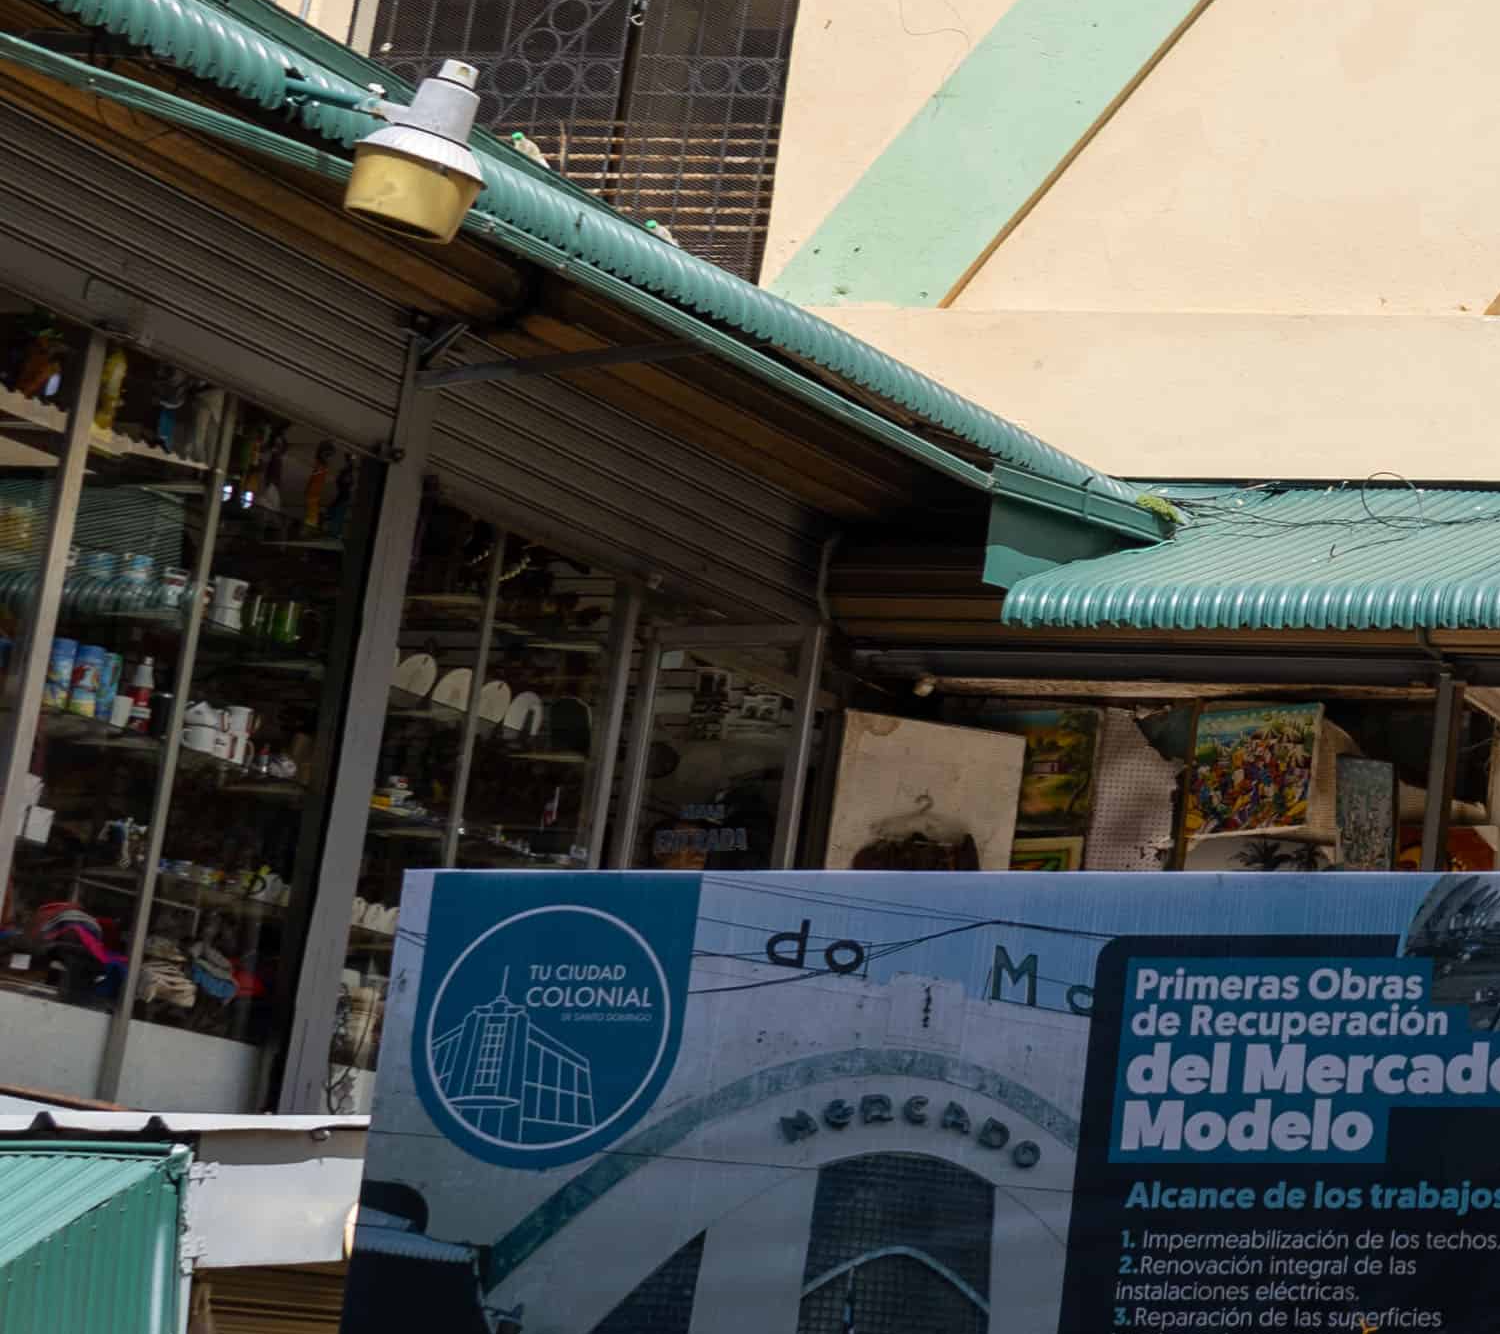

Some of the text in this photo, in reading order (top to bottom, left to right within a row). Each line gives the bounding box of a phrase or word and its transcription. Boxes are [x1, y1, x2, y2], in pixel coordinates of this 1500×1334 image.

[765, 919, 865, 975] do
[529, 963, 627, 981] TU CIUDAD
[1135, 968, 1424, 1001] Primeras Obras
[526, 985, 654, 1008] COLONIAL
[1131, 1004, 1449, 1044] de Recuperación
[1126, 1041, 1231, 1095] del
[1120, 1098, 1374, 1152] Modelo
[1124, 1180, 1255, 1210] Alcance
[1262, 1180, 1305, 1210] de
[1313, 1180, 1363, 1210] los
[1120, 1229, 1136, 1249] 1.
[1142, 1229, 1350, 1255] Impermeabilización
[1354, 1229, 1385, 1250] de
[1389, 1230, 1420, 1250] los
[1268, 1256, 1349, 1280] integral
[1353, 1256, 1383, 1276] de
[1388, 1256, 1417, 1276] las
[1115, 1281, 1360, 1302] instalaciones eléctricas.
[1258, 1308, 1289, 1328] de
[1294, 1308, 1322, 1328] las
[1327, 1307, 1442, 1333] superficies
